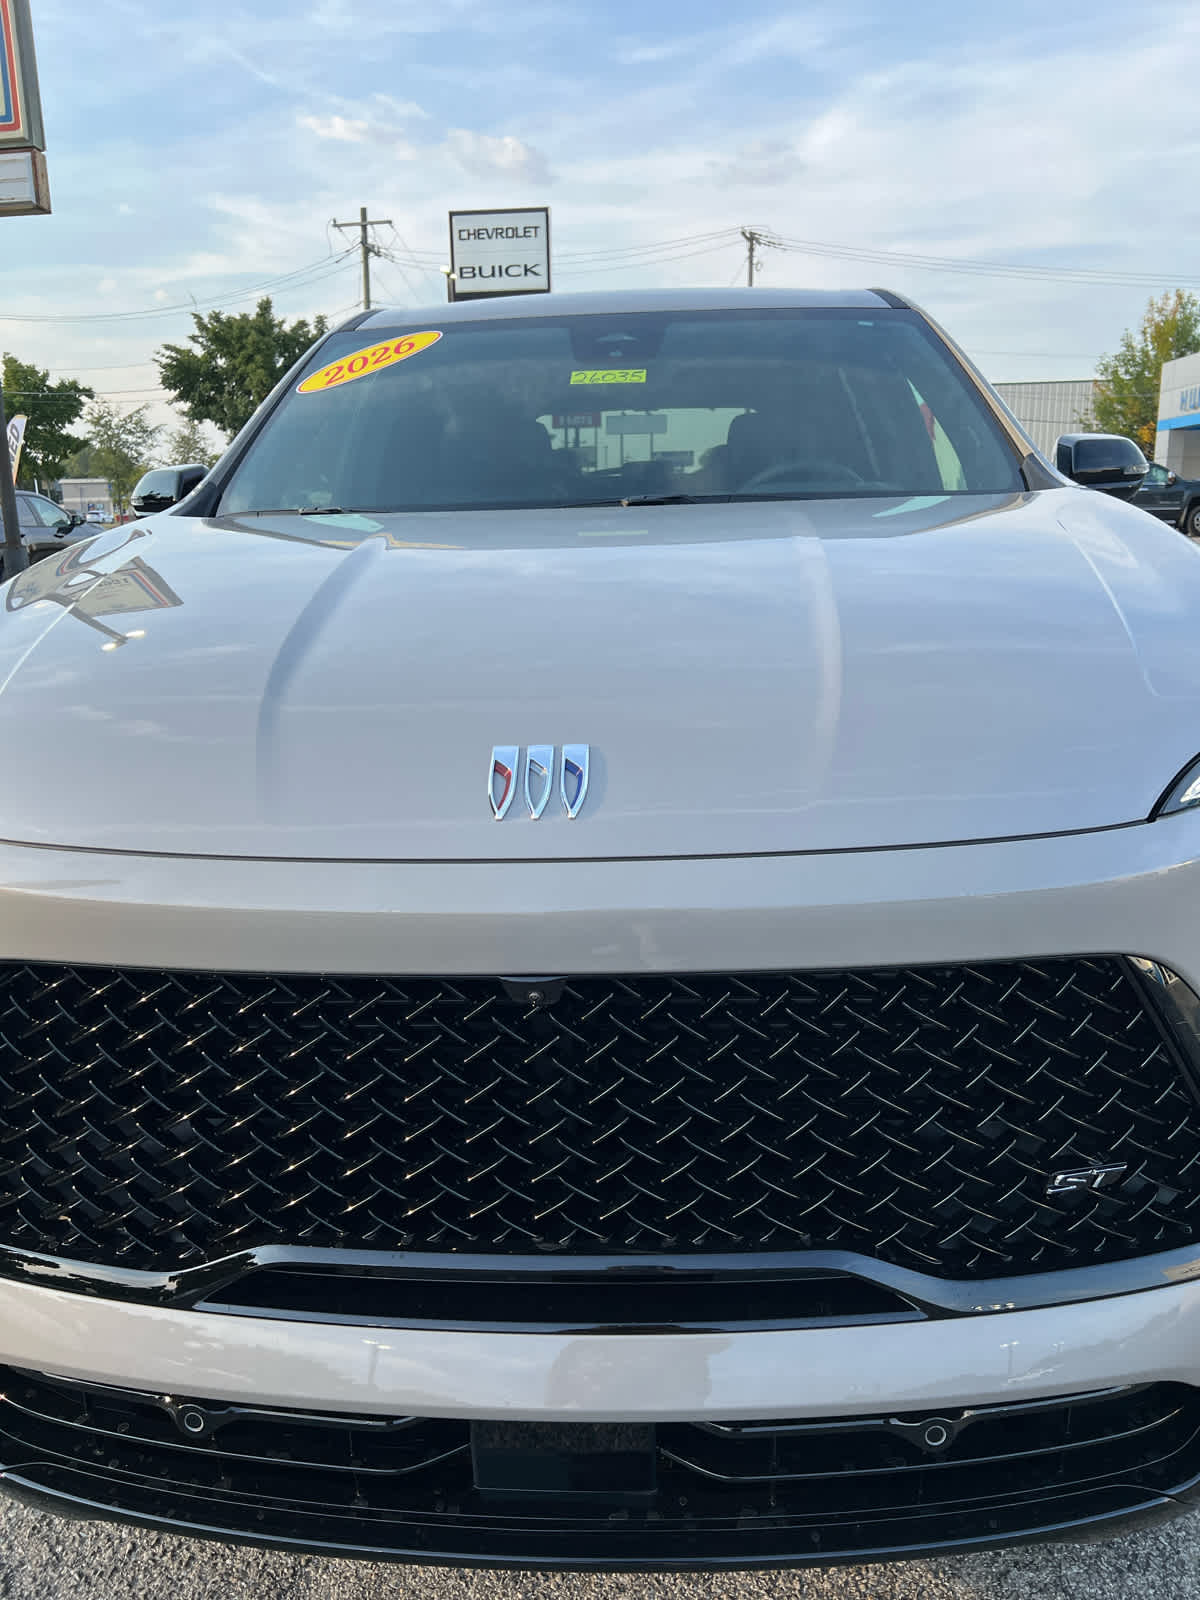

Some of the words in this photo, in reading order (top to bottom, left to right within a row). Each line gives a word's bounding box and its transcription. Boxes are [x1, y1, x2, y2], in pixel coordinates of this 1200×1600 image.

[458, 226, 540, 241] CHEVROLET
[459, 263, 542, 279] BUICK
[324, 336, 415, 386] 2026
[573, 371, 645, 383] 26035
[1046, 1163, 1128, 1196] ST
